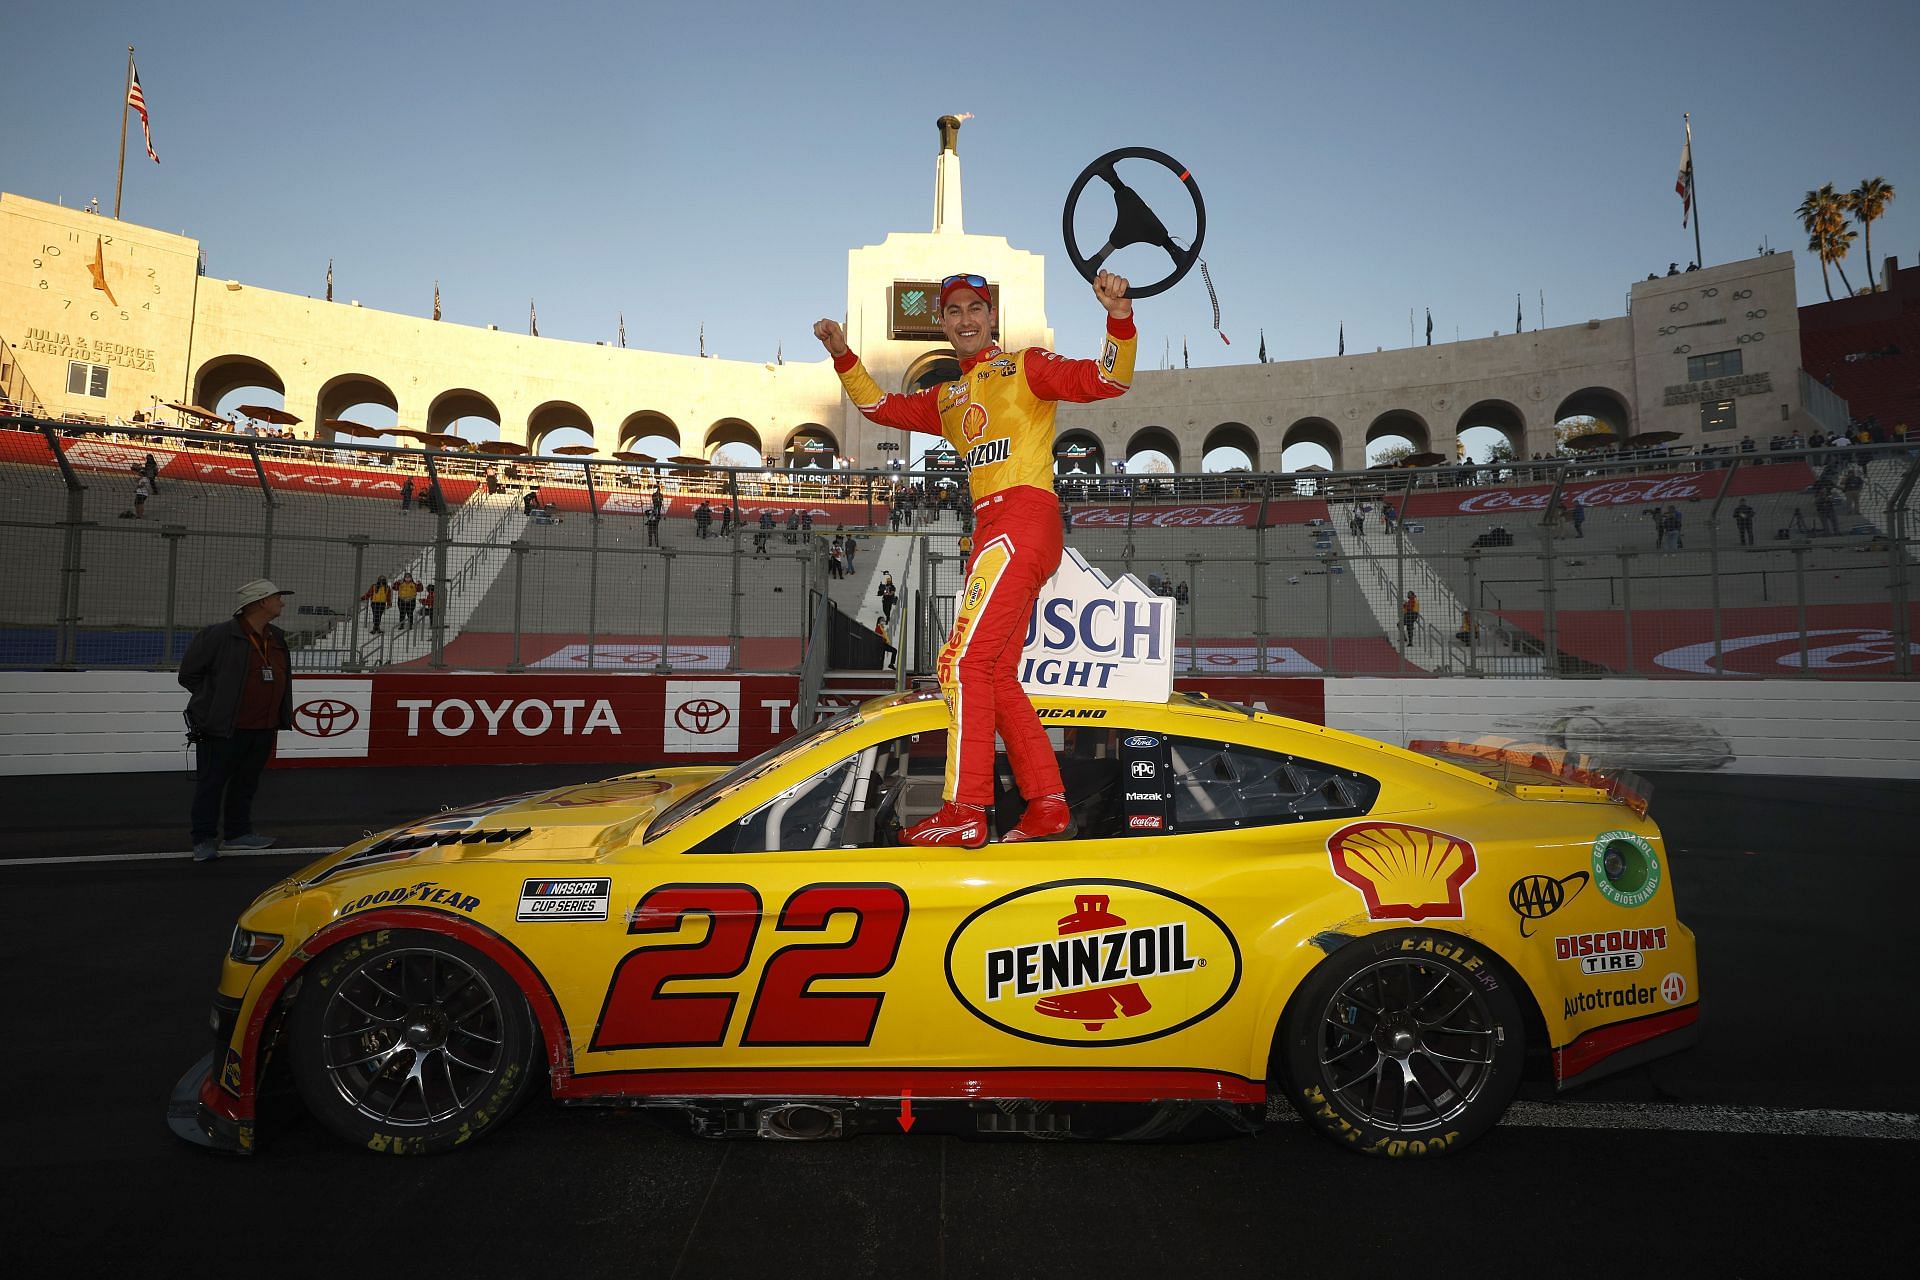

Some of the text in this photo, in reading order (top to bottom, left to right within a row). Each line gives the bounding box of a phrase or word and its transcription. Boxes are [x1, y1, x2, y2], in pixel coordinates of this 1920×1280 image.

[42, 244, 61, 257] 10
[32, 258, 43, 269] 9
[147, 268, 156, 279] 2
[39, 279, 49, 290] 8
[153, 284, 161, 295] 3
[1700, 287, 1718, 299] 70
[63, 299, 72, 310] 7
[142, 301, 151, 311] 4
[1669, 301, 1689, 313] 60
[90, 310, 99, 321] 6
[120, 311, 129, 321] 5
[1746, 309, 1768, 321] 90
[1658, 325, 1678, 336] 50
[24, 327, 156, 361] JULIA & GEORGE
[1736, 331, 1765, 345] 100
[1673, 344, 1692, 354] 40
[22, 339, 156, 373] ARGYROS PLAZA
[194, 463, 403, 491] TOYOTA
[1071, 505, 1250, 526] Coca-Cola
[1021, 658, 1119, 689] IGHT
[396, 698, 622, 737] TOYOTA
[1036, 708, 1107, 719] OGANO
[1132, 762, 1154, 777] PPG
[1125, 793, 1163, 801] Mazak
[1130, 816, 1160, 828] Coca-Cola
[961, 828, 977, 840] 22
[551, 882, 597, 895] NASCAR
[531, 900, 596, 912] CUP SERIES
[1555, 927, 1668, 960] DISCOUNT
[1400, 937, 1483, 973] EAGLE
[587, 882, 909, 1053] 22
[986, 922, 1198, 1002] PENNZOIL
[1586, 954, 1637, 972] TIRE
[1564, 983, 1658, 1021] Autotrader
